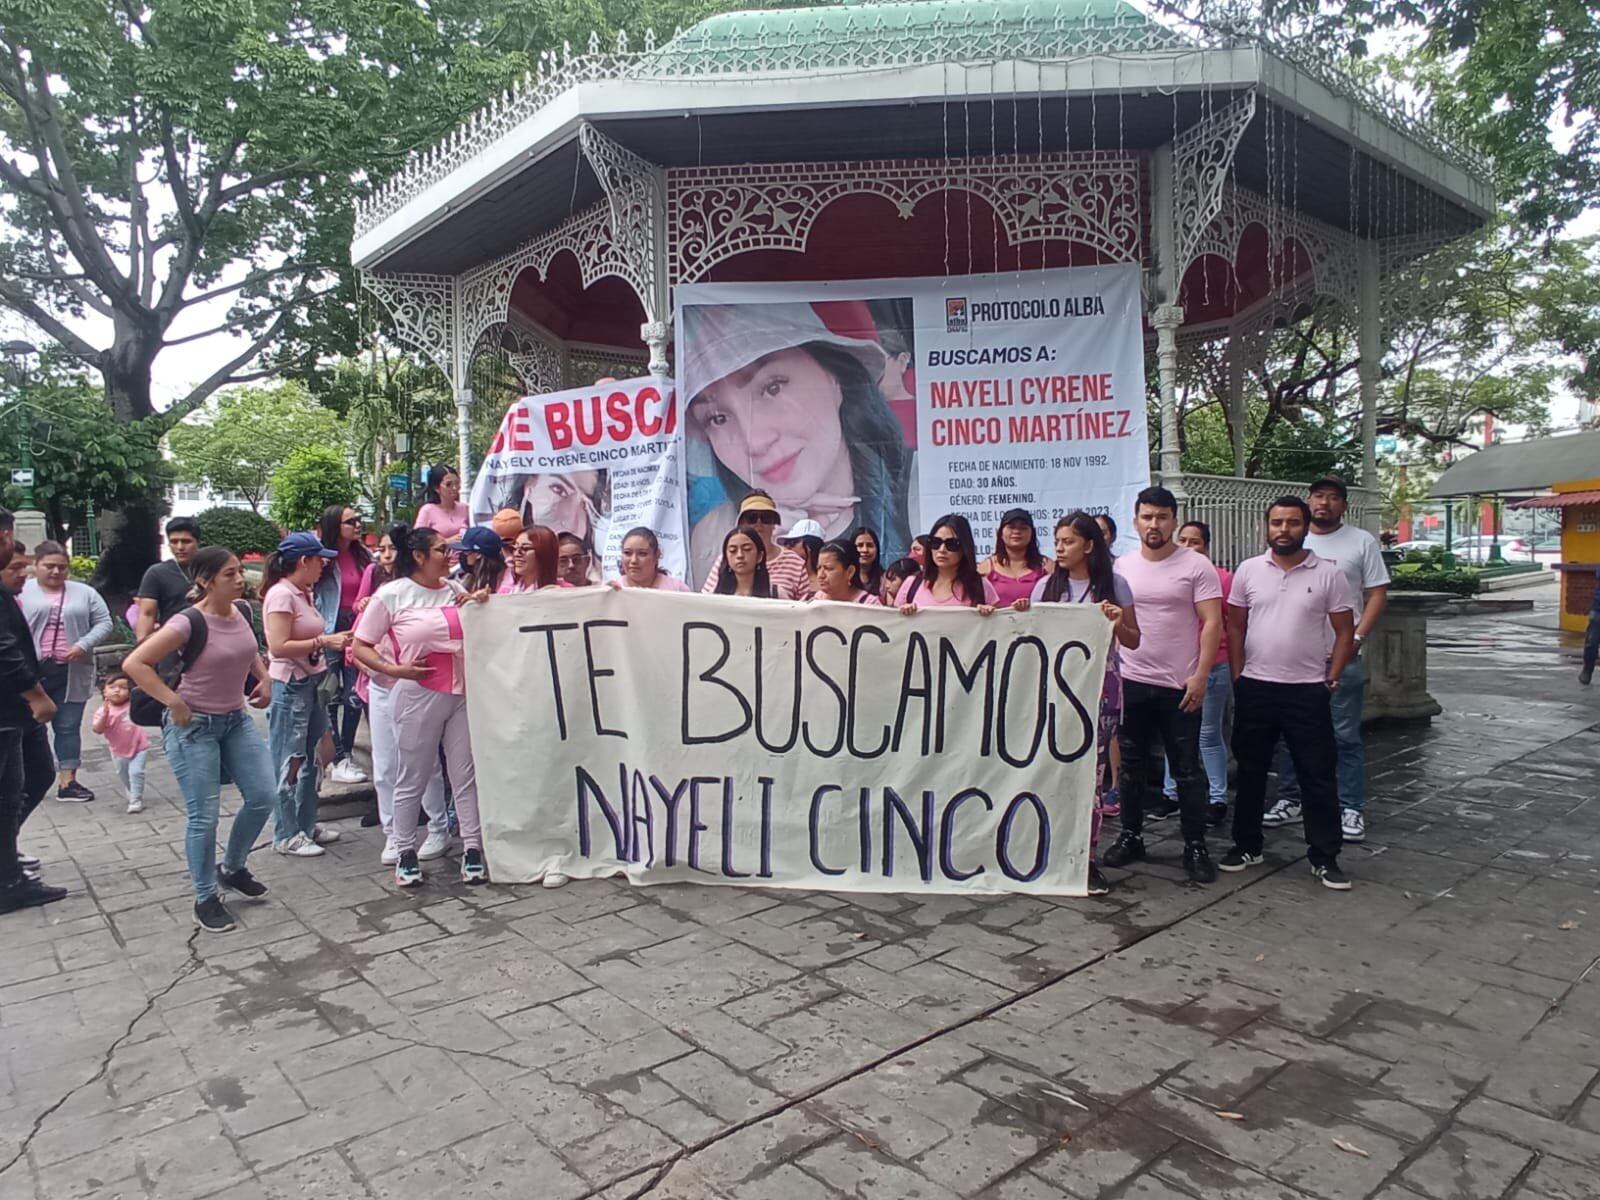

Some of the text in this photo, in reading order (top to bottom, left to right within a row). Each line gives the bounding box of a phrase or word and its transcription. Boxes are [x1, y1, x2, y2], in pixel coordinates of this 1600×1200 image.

[971, 296, 1105, 322] PROTOCOLO ALBA
[928, 346, 1056, 366] BUSCAMOS A:
[930, 373, 1114, 408] NAYELI CYRENE
[931, 408, 1132, 446] CINCO MARTÍNEZ
[487, 456, 534, 471] NAYELY
[538, 451, 588, 467] CYRENE
[589, 447, 628, 463] CINCO
[949, 455, 1110, 473] FECHA DE NACIMIENTO: 18 NOV 1992.
[949, 475, 1018, 489] EDAD: 30 AÑOS.
[950, 492, 1037, 506] GÉNERO: FEMENINO.
[981, 511, 993, 522] DE
[1052, 508, 1064, 519] 22
[982, 528, 993, 539] DE
[519, 620, 1093, 768] TE BUSCAMOS
[576, 762, 1051, 884] NAYELI CINCO
